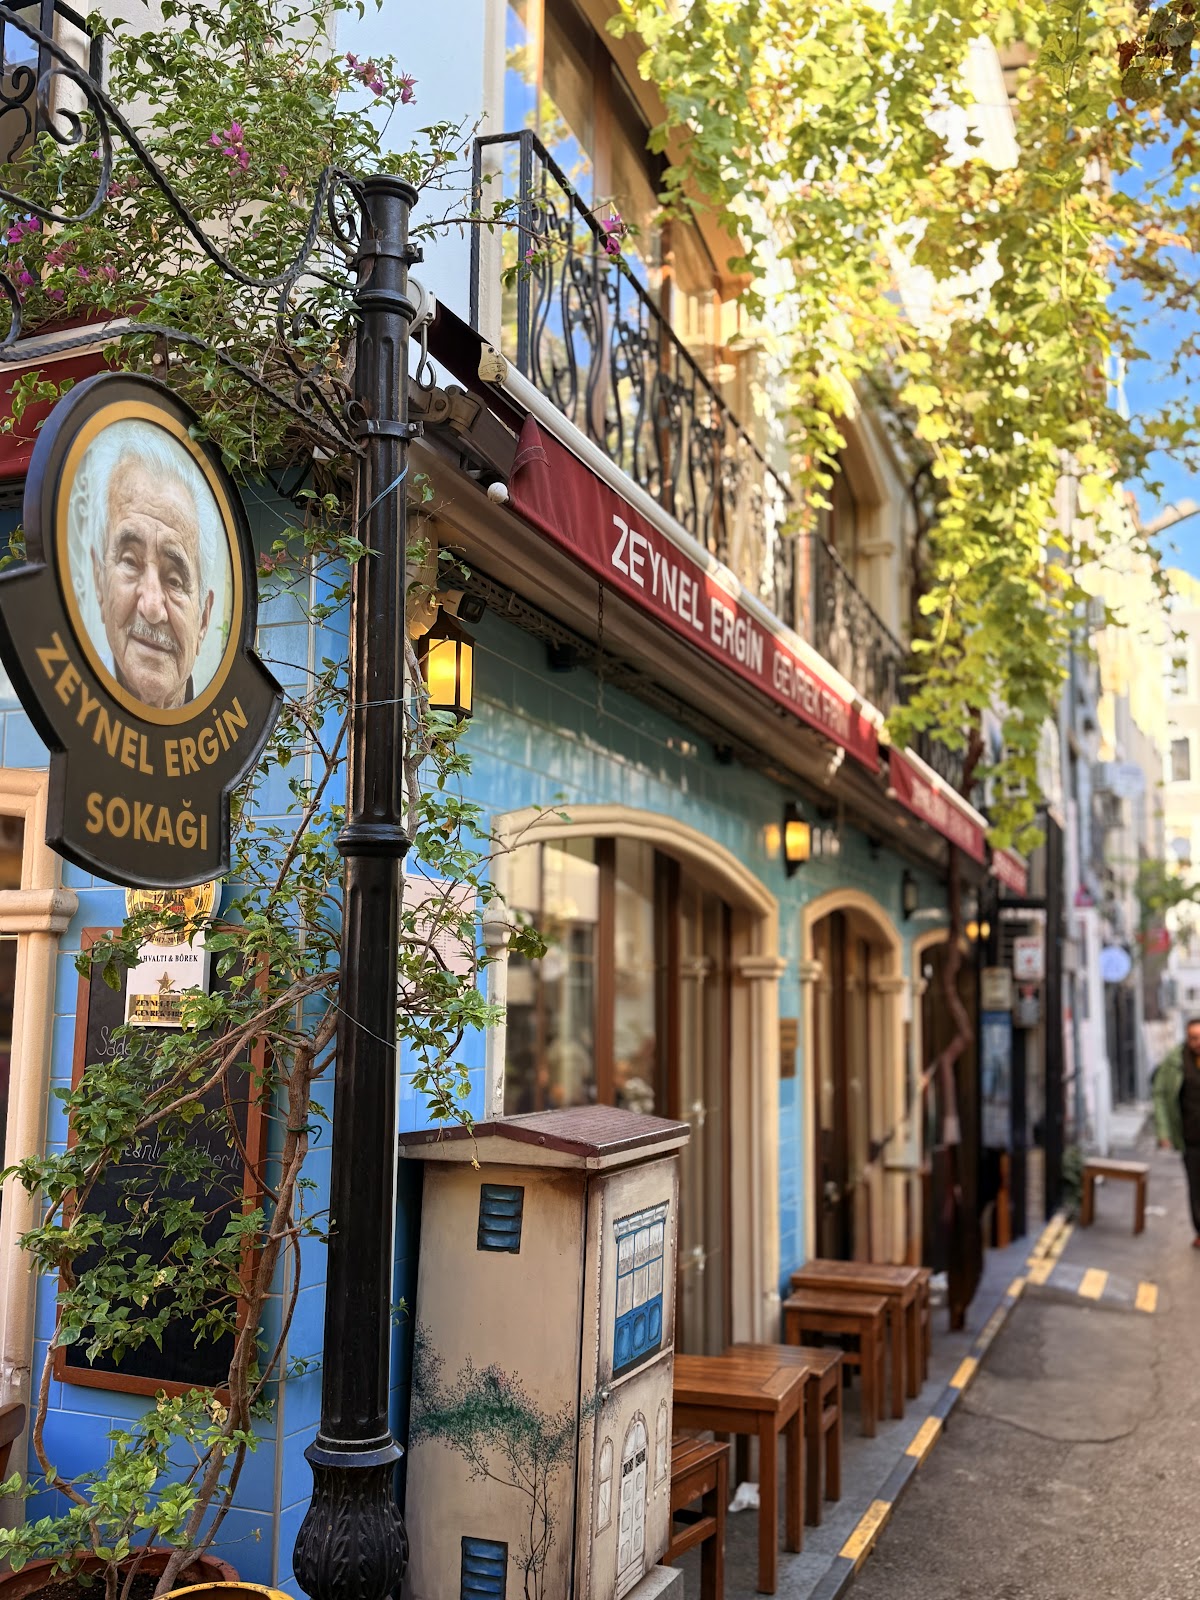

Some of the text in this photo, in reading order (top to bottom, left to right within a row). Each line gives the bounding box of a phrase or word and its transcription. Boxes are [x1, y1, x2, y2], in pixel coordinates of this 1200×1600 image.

[612, 514, 704, 632] ZEYNEL
[710, 597, 764, 676] ERGİN
[35, 631, 249, 777] ZEYNEL ERGİN
[85, 792, 208, 850] SOKAĞI
